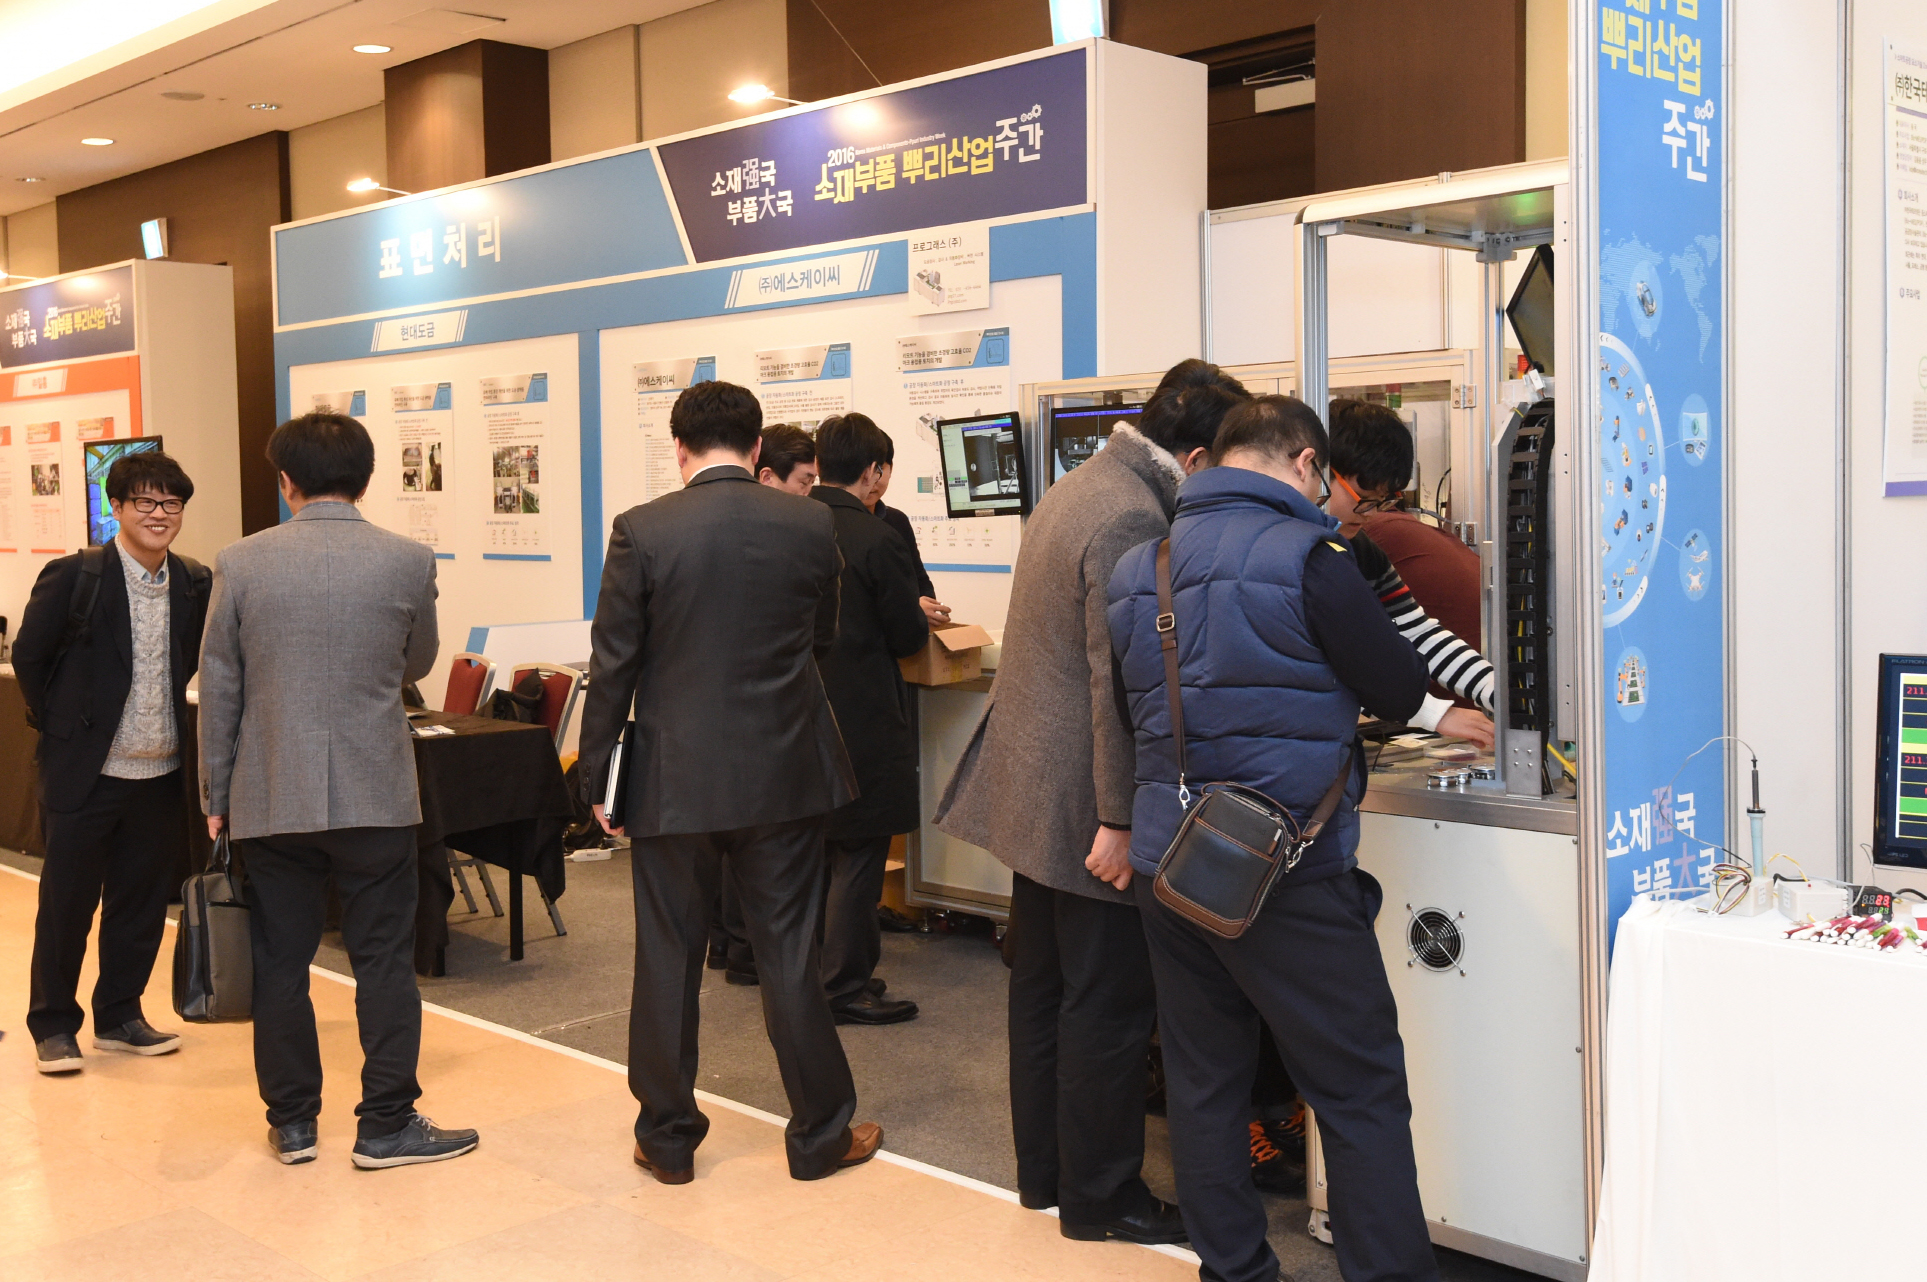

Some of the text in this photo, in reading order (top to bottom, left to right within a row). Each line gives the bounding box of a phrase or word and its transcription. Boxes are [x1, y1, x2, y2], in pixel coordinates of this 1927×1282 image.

[1601, 7, 1701, 96] 뿌리산업
[827, 146, 855, 167] 2016
[1662, 99, 1711, 182] 주간
[711, 157, 776, 196] 소재强국
[814, 117, 1044, 204] 소재부품 뿌리산업 주간
[727, 187, 793, 226] 부품大국
[378, 215, 501, 279] 표면처리
[912, 236, 962, 252] 프로그래스 (주)
[758, 265, 840, 295] (주)에스케이씨
[400, 321, 435, 342] 현대도금
